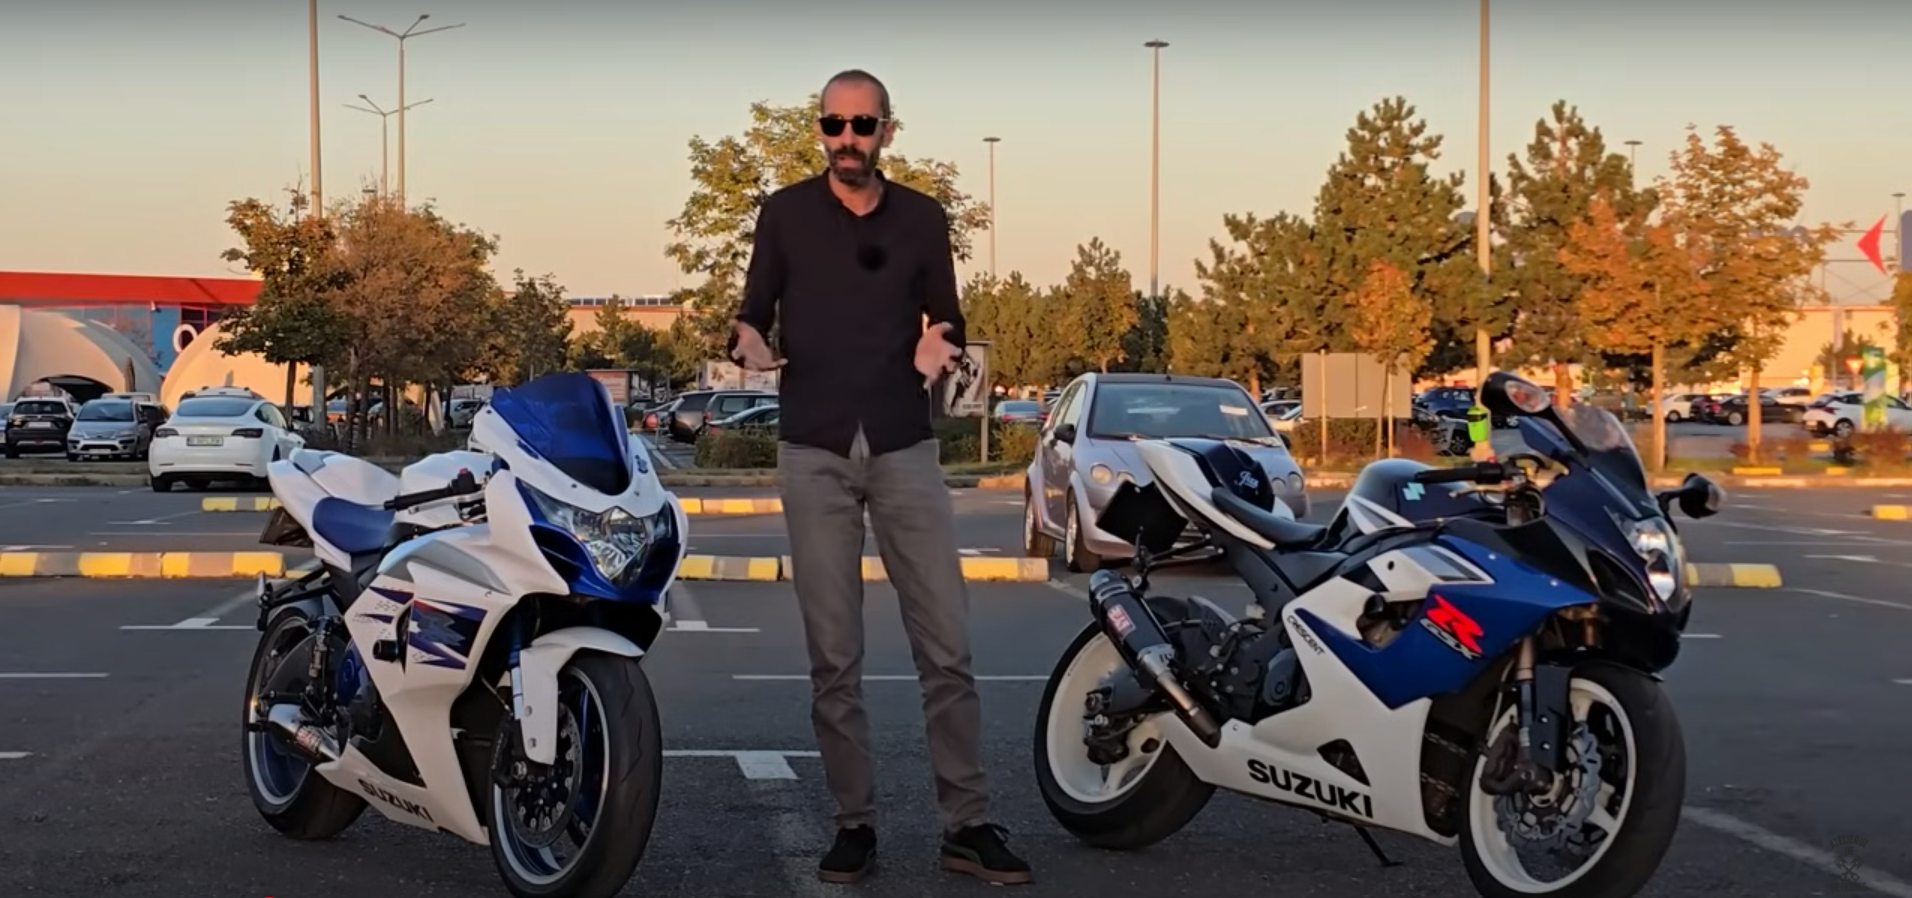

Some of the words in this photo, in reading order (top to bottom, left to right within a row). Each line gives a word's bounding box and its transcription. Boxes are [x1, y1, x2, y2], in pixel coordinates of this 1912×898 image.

[1287, 615, 1326, 656] CRESCENT
[358, 778, 434, 823] SUZUKI
[1247, 758, 1374, 818] SUZUKI
